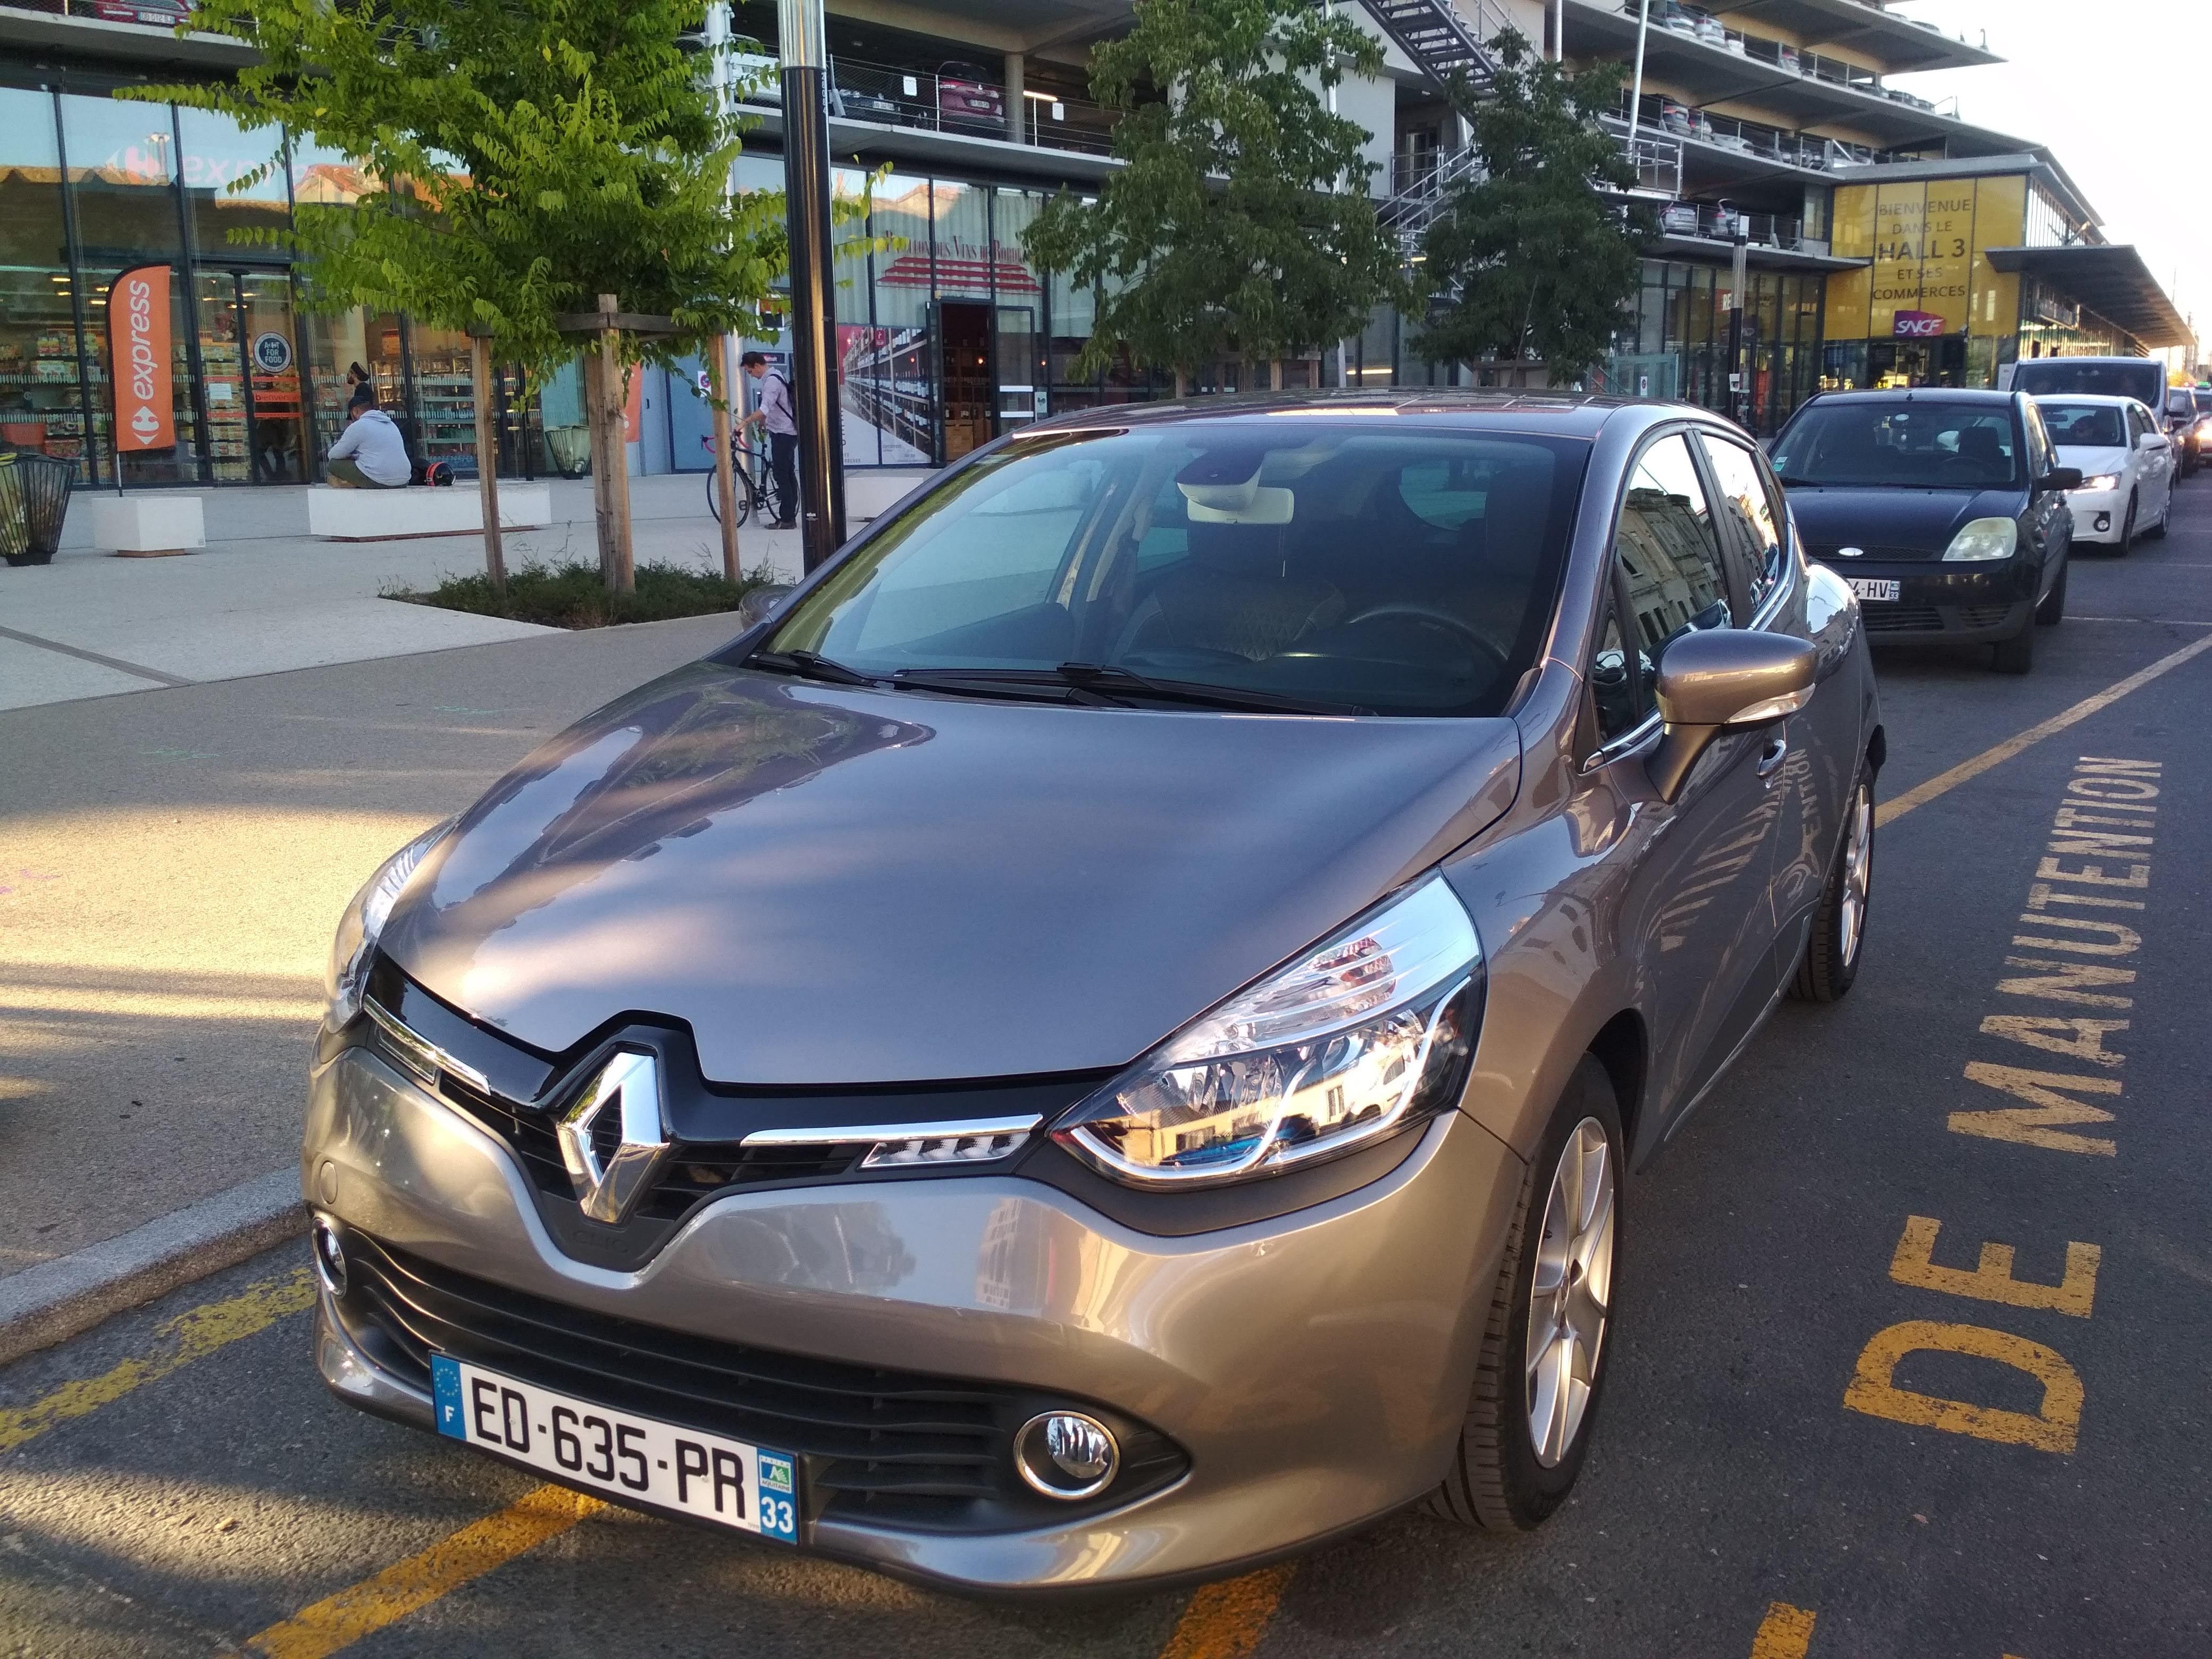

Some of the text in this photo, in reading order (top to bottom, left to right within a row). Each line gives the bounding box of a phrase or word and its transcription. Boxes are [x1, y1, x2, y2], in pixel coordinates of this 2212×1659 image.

[1879, 198, 1971, 215] BIENVENUE
[1892, 220, 1952, 234] DANS LE
[1878, 238, 1965, 260] HALL 3
[1897, 267, 1942, 280] ET SES
[1874, 285, 1966, 300] COMMERCES
[1895, 319, 1944, 333] SNCF
[130, 280, 158, 399] express
[1889, 591, 1898, 600] 33
[1947, 756, 2163, 1158] MANUTENTION
[1843, 1215, 2101, 1455] DE
[445, 1405, 455, 1422] F
[471, 1377, 746, 1519] ED-635-PR
[761, 1479, 791, 1492] AQUITAINE
[761, 1496, 794, 1534] 33
